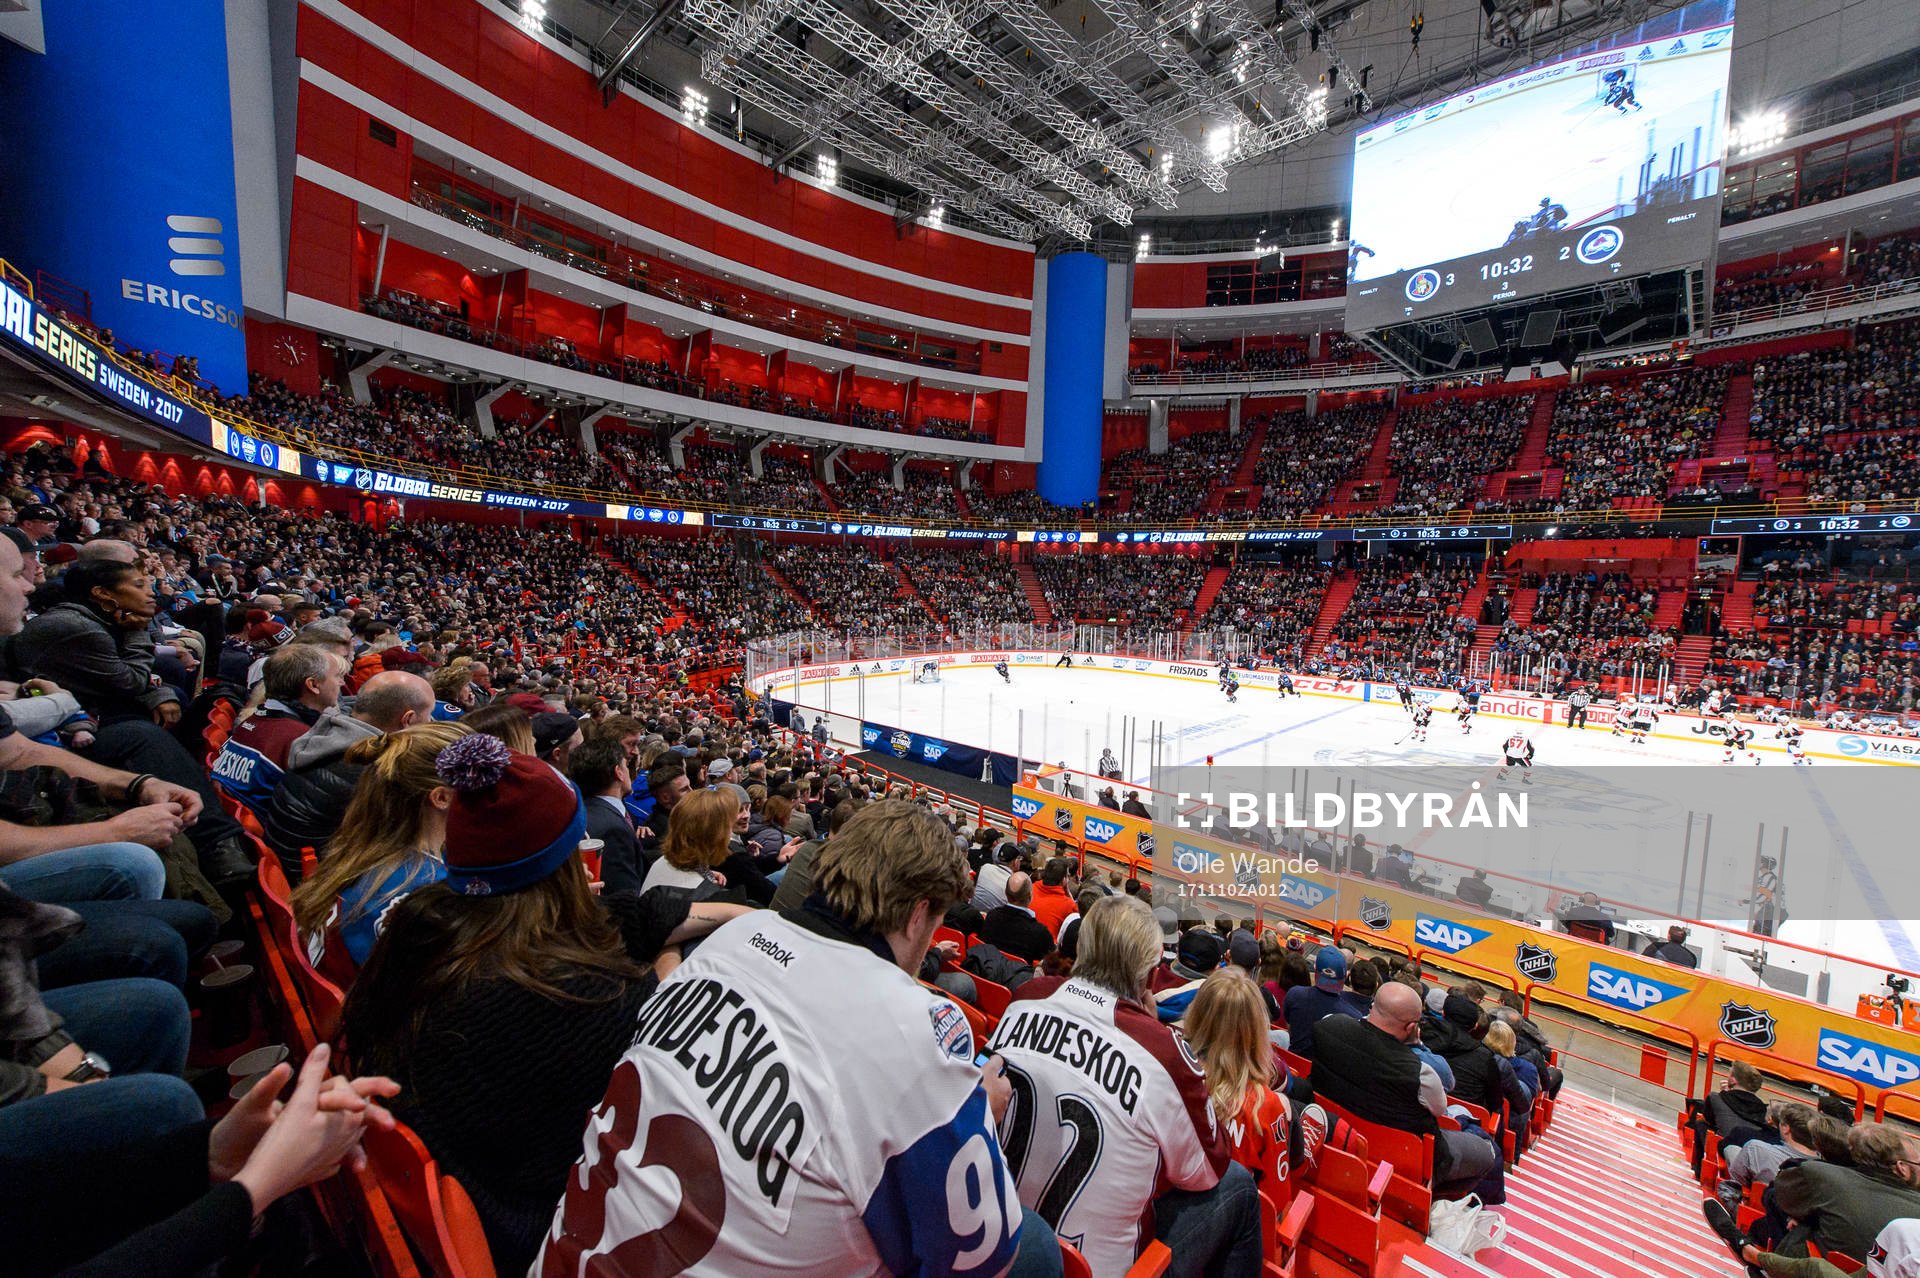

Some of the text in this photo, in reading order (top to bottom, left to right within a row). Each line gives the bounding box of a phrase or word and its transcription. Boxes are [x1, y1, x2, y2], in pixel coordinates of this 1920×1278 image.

[1667, 212, 1696, 223] PENALTY
[1445, 246, 1571, 286] 3 10:32 2
[1501, 281, 1509, 290] 3
[1492, 290, 1516, 300] PERIOD
[35, 312, 97, 382] SERIES
[100, 363, 150, 409] SWEDEN
[156, 397, 183, 424] 2017
[486, 493, 538, 508] SWEDEN
[542, 500, 570, 511] 2017
[762, 520, 780, 529] 10:32
[1793, 522, 1801, 530] 3
[1819, 520, 1860, 530] 10:32
[949, 531, 984, 539] SWEDEN
[987, 532, 1008, 540] 2017
[1249, 532, 1292, 540] SWEDEN
[1417, 530, 1441, 538] 10:32
[971, 654, 1010, 663] BAUHAUS
[1169, 665, 1208, 677] FRISTADS
[1238, 672, 1275, 682] EUROMASTER
[1293, 679, 1356, 694] CCM
[1479, 699, 1539, 718] andic
[863, 729, 878, 743] SAP
[923, 746, 942, 760] SAP
[1012, 798, 1038, 817] SAP
[1086, 819, 1116, 841] SAP
[1365, 906, 1385, 922] NHL
[1416, 917, 1473, 951] SAP
[747, 932, 796, 968] Reebok
[1521, 955, 1553, 975] NHL
[1064, 983, 1108, 1007] Reebok
[1588, 967, 1664, 1010] SAP
[935, 1008, 964, 1044] STADIUM
[1729, 1015, 1769, 1036] NHL
[993, 1011, 1143, 1118] LANDESKOG
[1818, 1037, 1920, 1085] SAP
